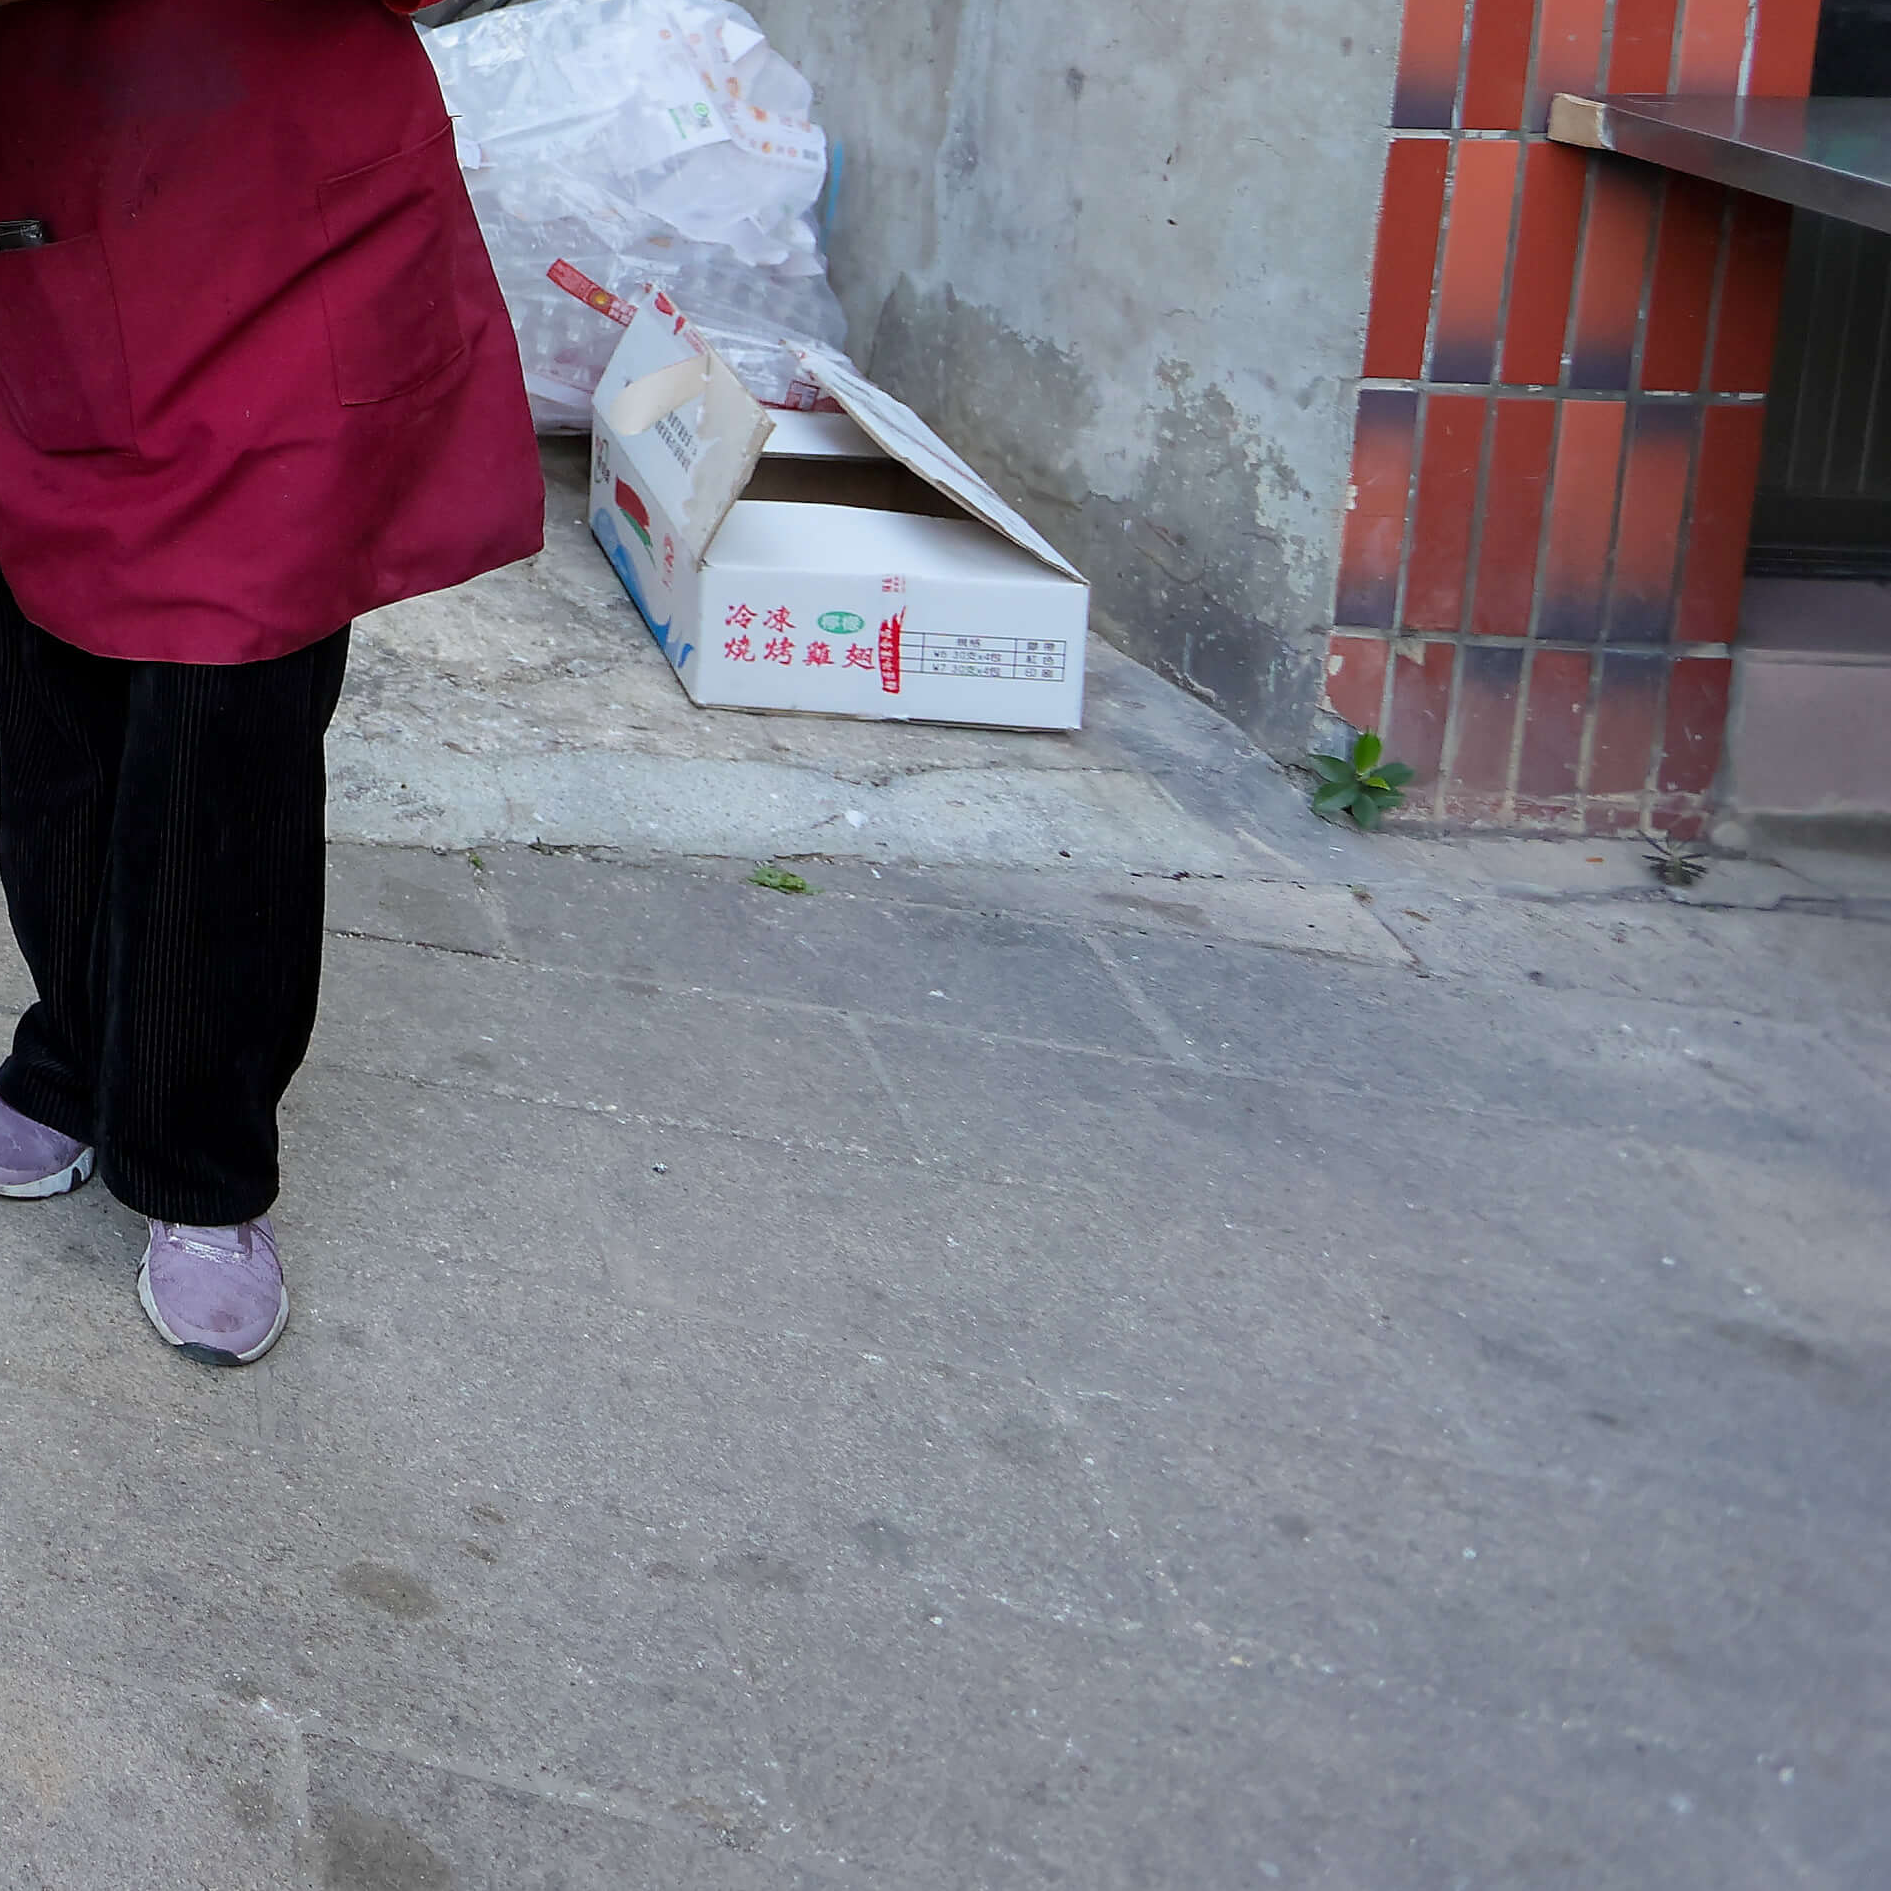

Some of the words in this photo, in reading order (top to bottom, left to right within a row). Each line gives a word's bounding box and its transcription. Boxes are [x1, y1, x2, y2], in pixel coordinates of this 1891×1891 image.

[724, 603, 796, 633] 冷凍
[724, 634, 876, 670] 燒烤雞翅
